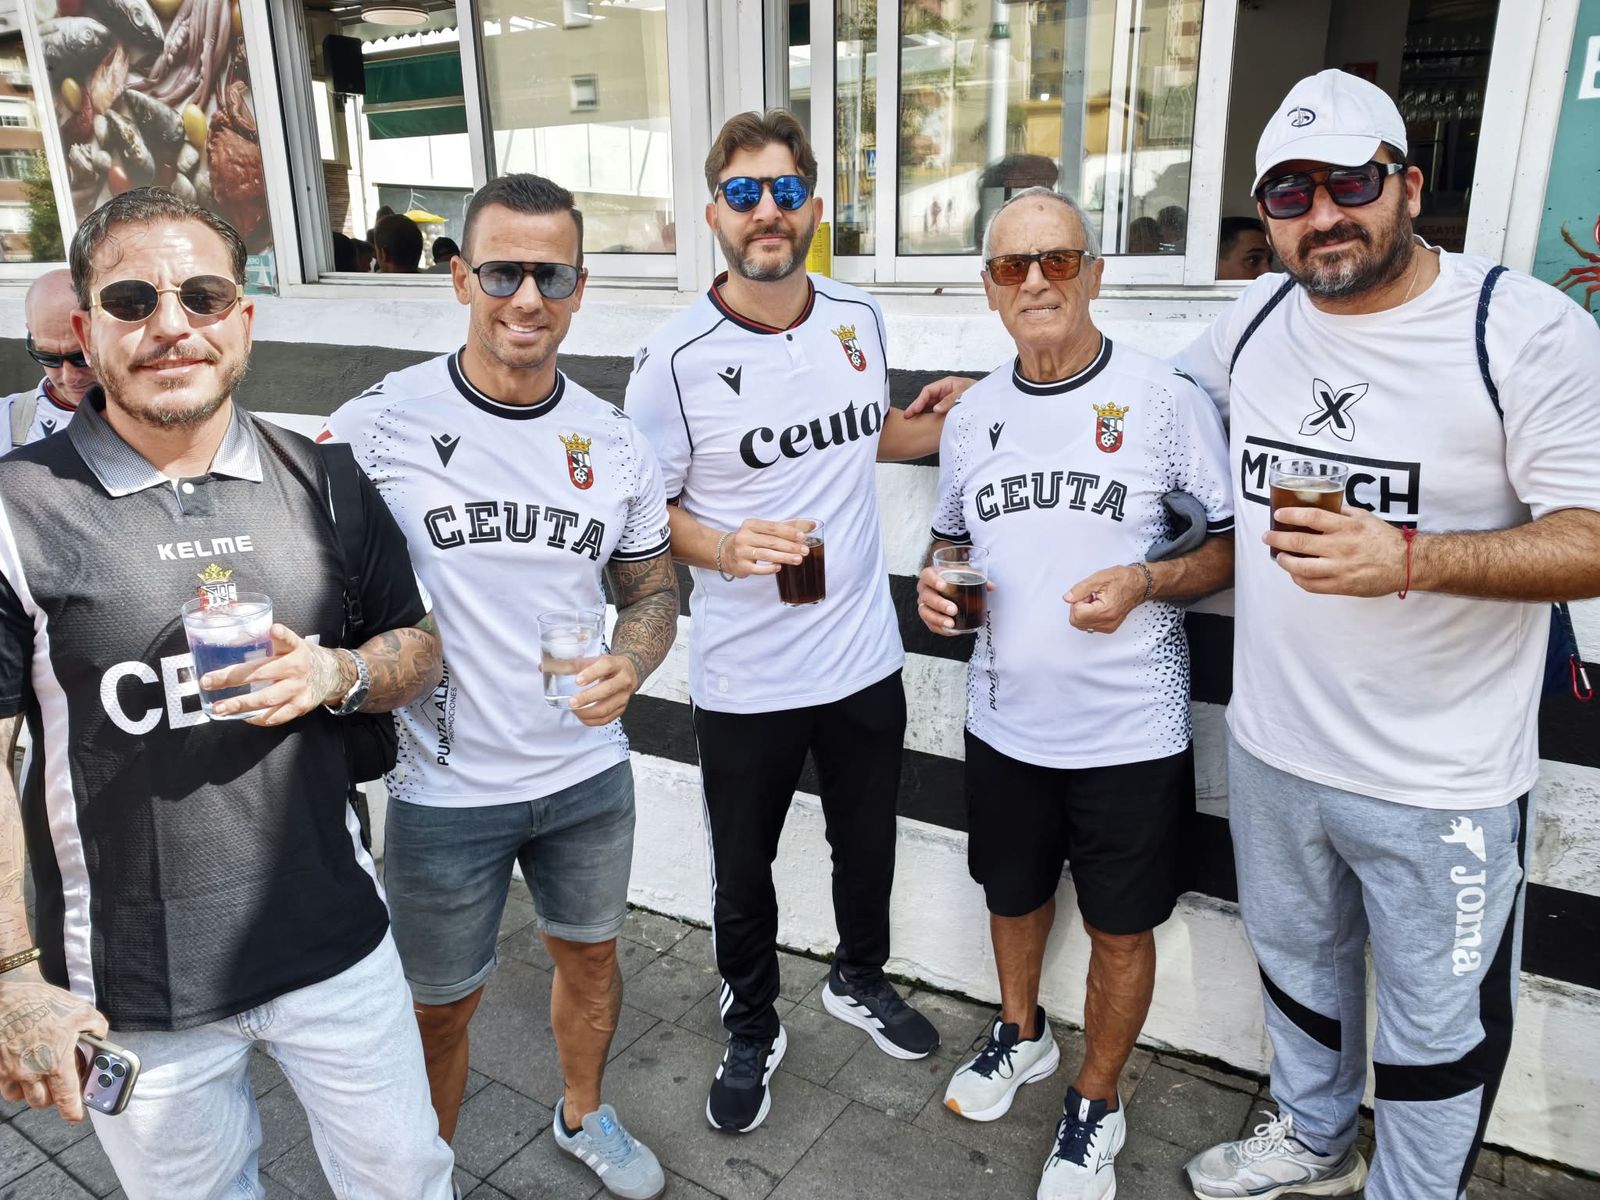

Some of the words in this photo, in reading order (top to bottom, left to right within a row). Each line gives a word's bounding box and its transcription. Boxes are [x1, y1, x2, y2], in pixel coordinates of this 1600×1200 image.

[740, 400, 881, 469] ceuta
[1309, 391, 1355, 429] X
[975, 471, 1127, 522] CEUTA
[1241, 449, 1421, 515] MCH
[157, 535, 254, 561] KELME
[424, 501, 605, 561] CEUTA
[437, 718, 450, 766] PUNTA
[448, 687, 458, 743] PROMOCIONES
[1450, 866, 1487, 977] Joma
